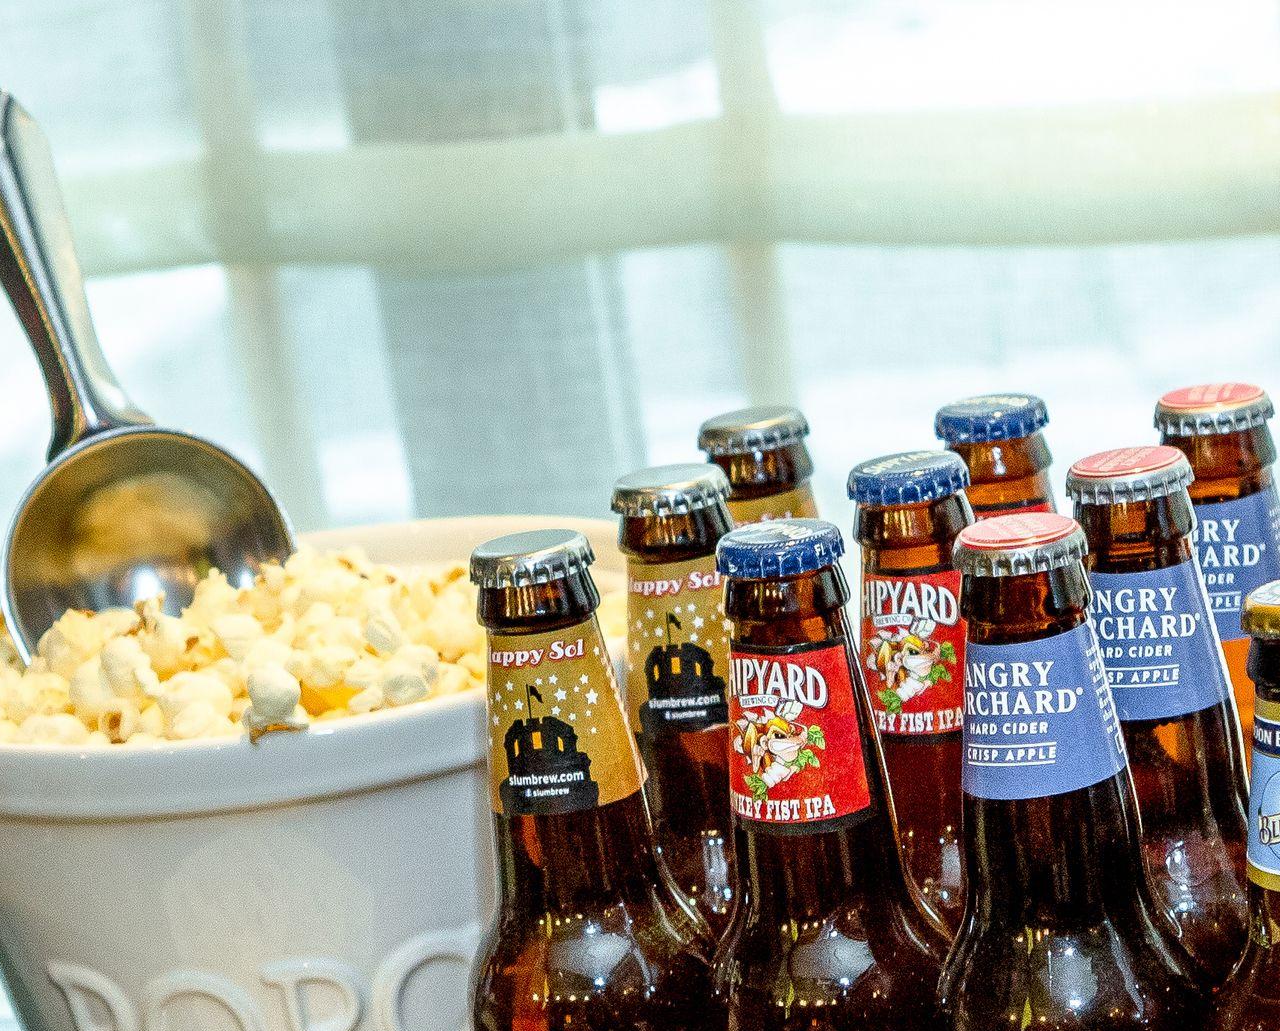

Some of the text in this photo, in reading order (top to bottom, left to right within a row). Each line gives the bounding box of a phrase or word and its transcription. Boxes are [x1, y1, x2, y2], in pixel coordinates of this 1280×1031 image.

[629, 571, 721, 595] appy Sol
[863, 580, 960, 626] HIPYARD
[1093, 612, 1196, 640] CHARD
[489, 638, 585, 667] appy Sol
[1128, 643, 1173, 659] CIDER
[729, 658, 830, 709] HIPYARD
[964, 660, 1055, 689] ANGRY
[1130, 666, 1180, 683] APPLE
[648, 695, 721, 709] slumbrew.com
[741, 695, 768, 706] BREWING
[964, 689, 1078, 716] RCHARD
[899, 711, 934, 734] FIST
[936, 706, 964, 731] IPA
[969, 720, 1048, 735] HARD CIDER
[967, 746, 1057, 762] CRISP APPLE
[508, 770, 585, 786] slumbrew.com
[532, 786, 570, 797] slumbrew
[766, 794, 836, 821] FIST IPA
